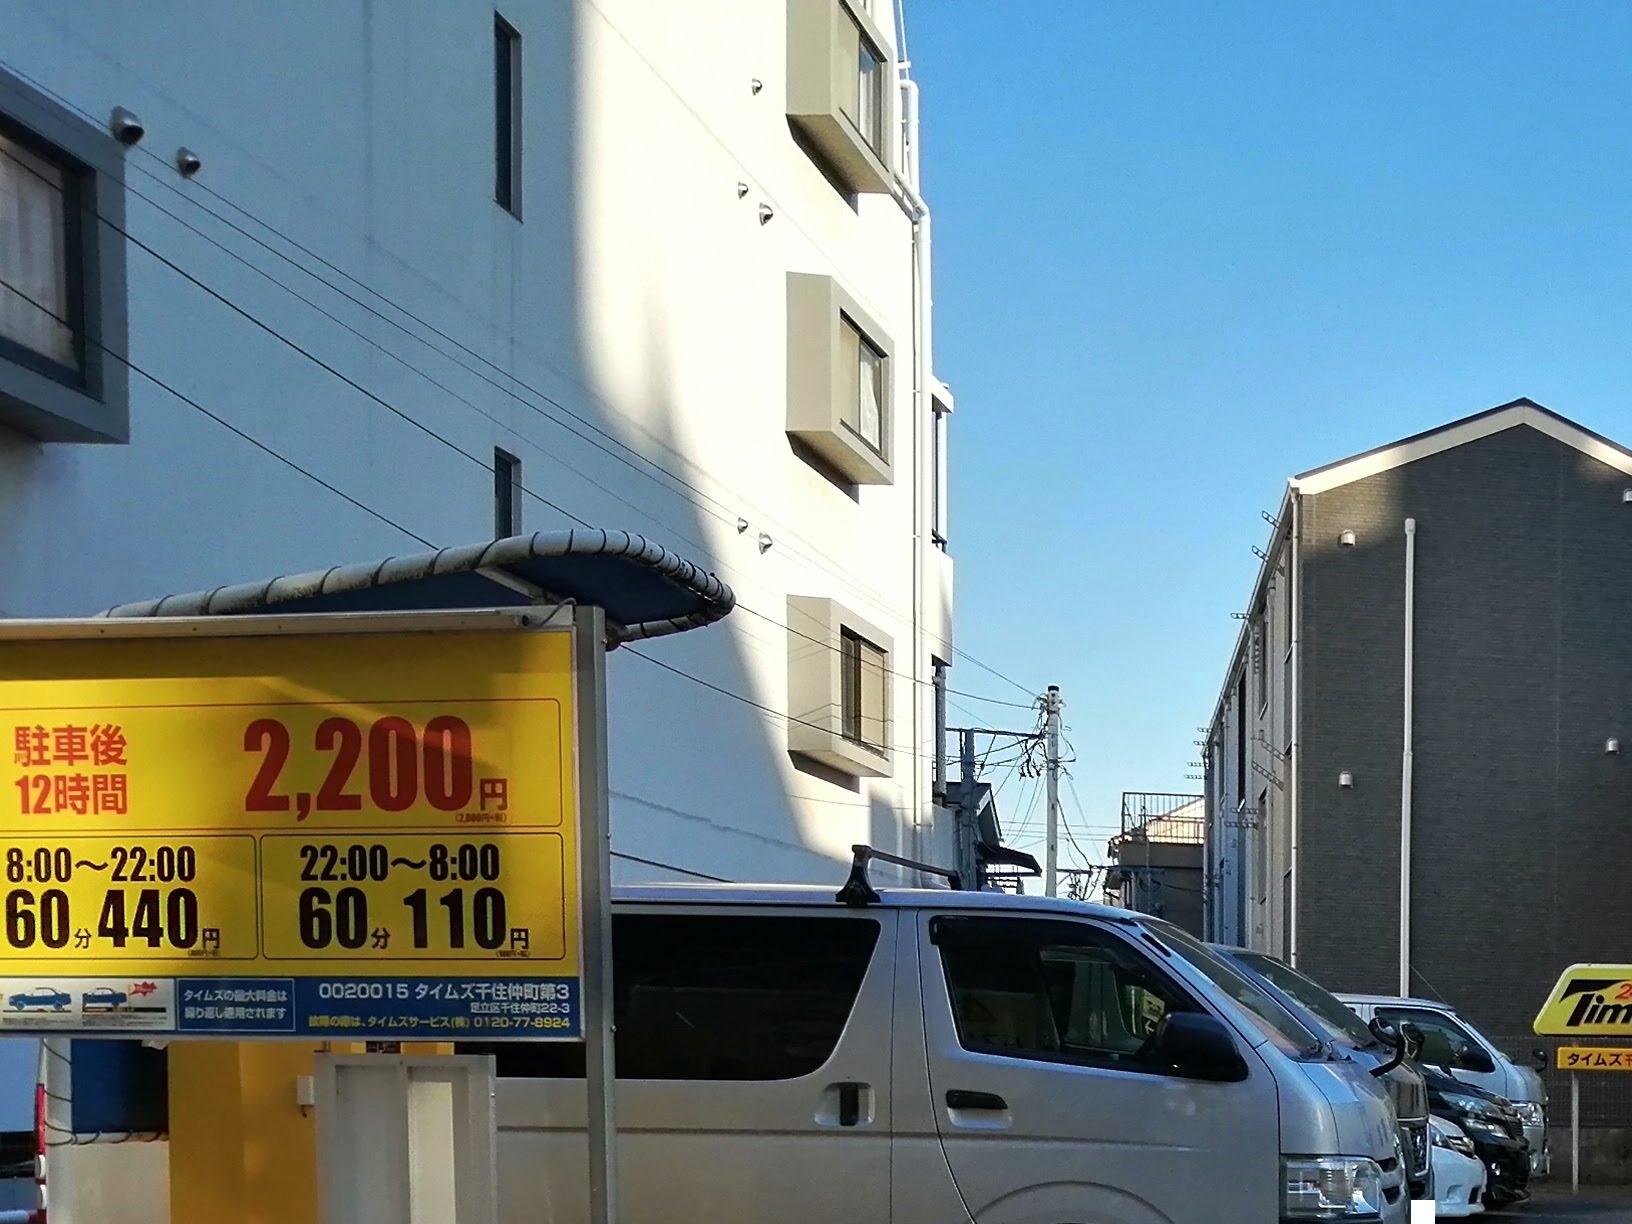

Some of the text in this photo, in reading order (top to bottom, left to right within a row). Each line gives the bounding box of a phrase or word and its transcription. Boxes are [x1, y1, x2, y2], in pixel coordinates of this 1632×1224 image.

[14, 724, 128, 767] 駐車後
[14, 772, 128, 815] 12時間
[319, 983, 570, 1000] 0020015 タイムズ千住仲町第3
